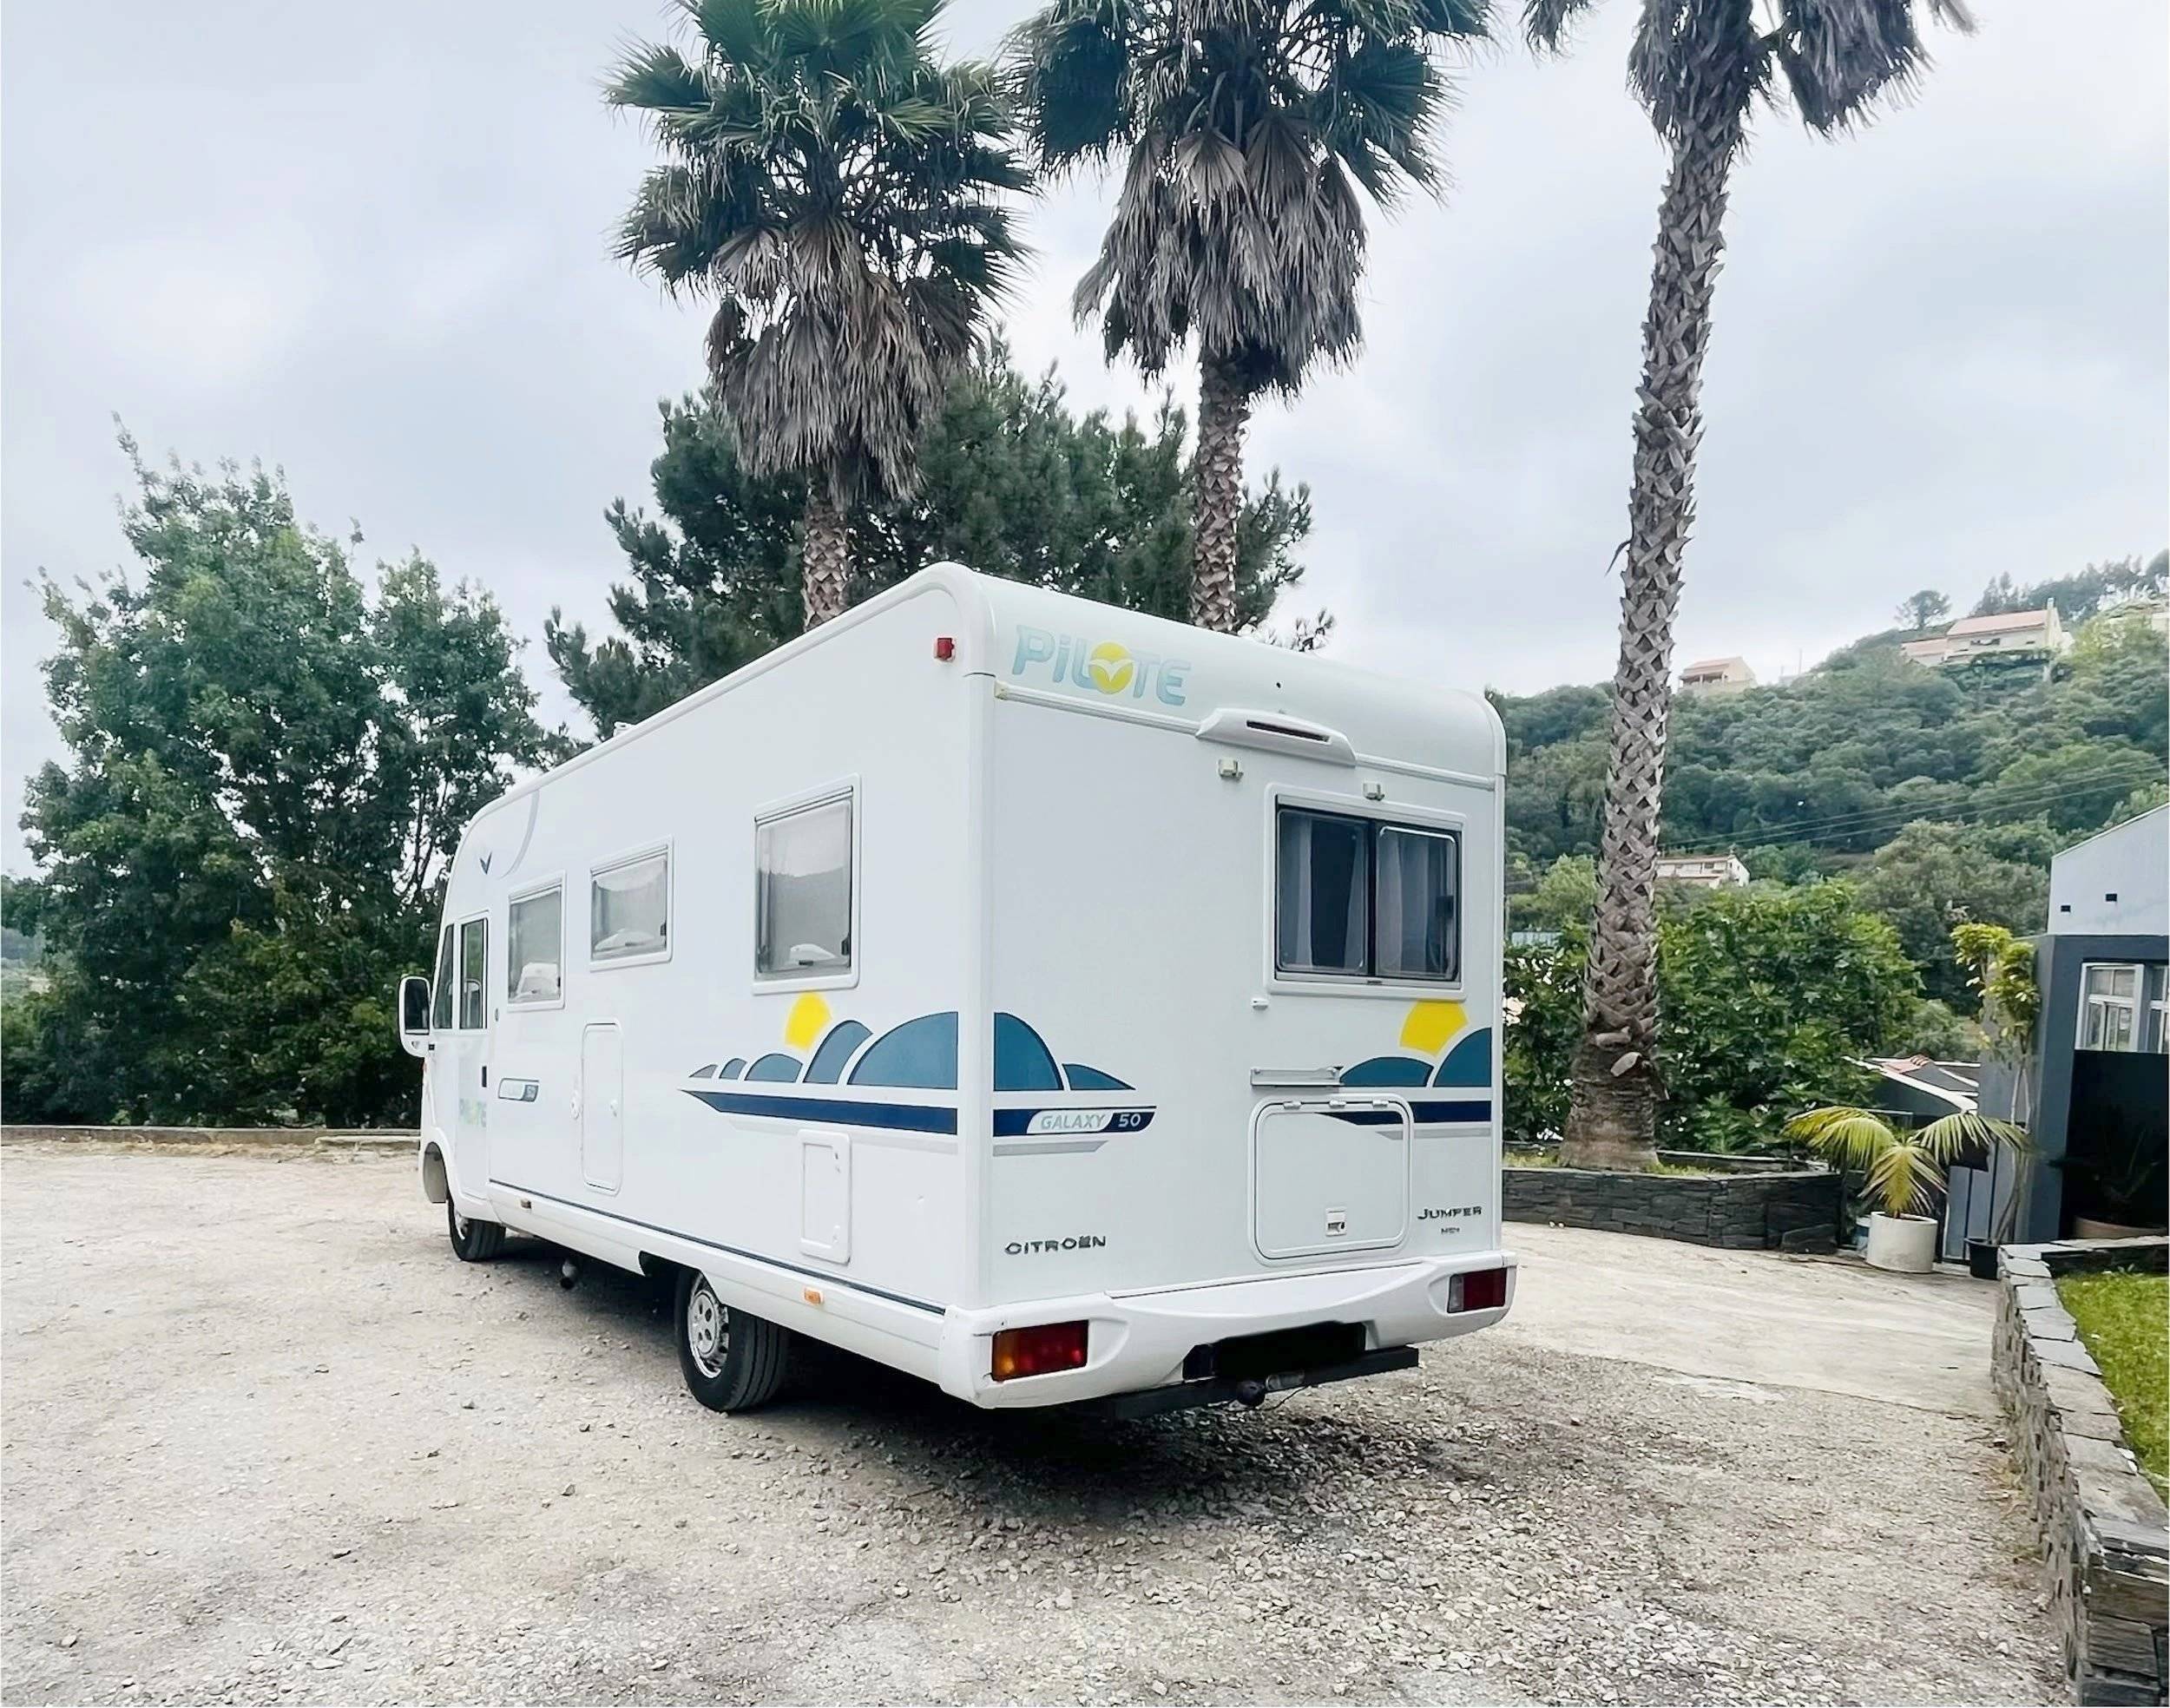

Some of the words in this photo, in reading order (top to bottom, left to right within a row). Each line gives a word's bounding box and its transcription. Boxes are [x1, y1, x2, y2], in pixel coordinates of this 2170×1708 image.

[1042, 1114, 1106, 1130] GALAXY
[1118, 1113, 1141, 1127] 50
[1417, 1206, 1482, 1219] JUMPER
